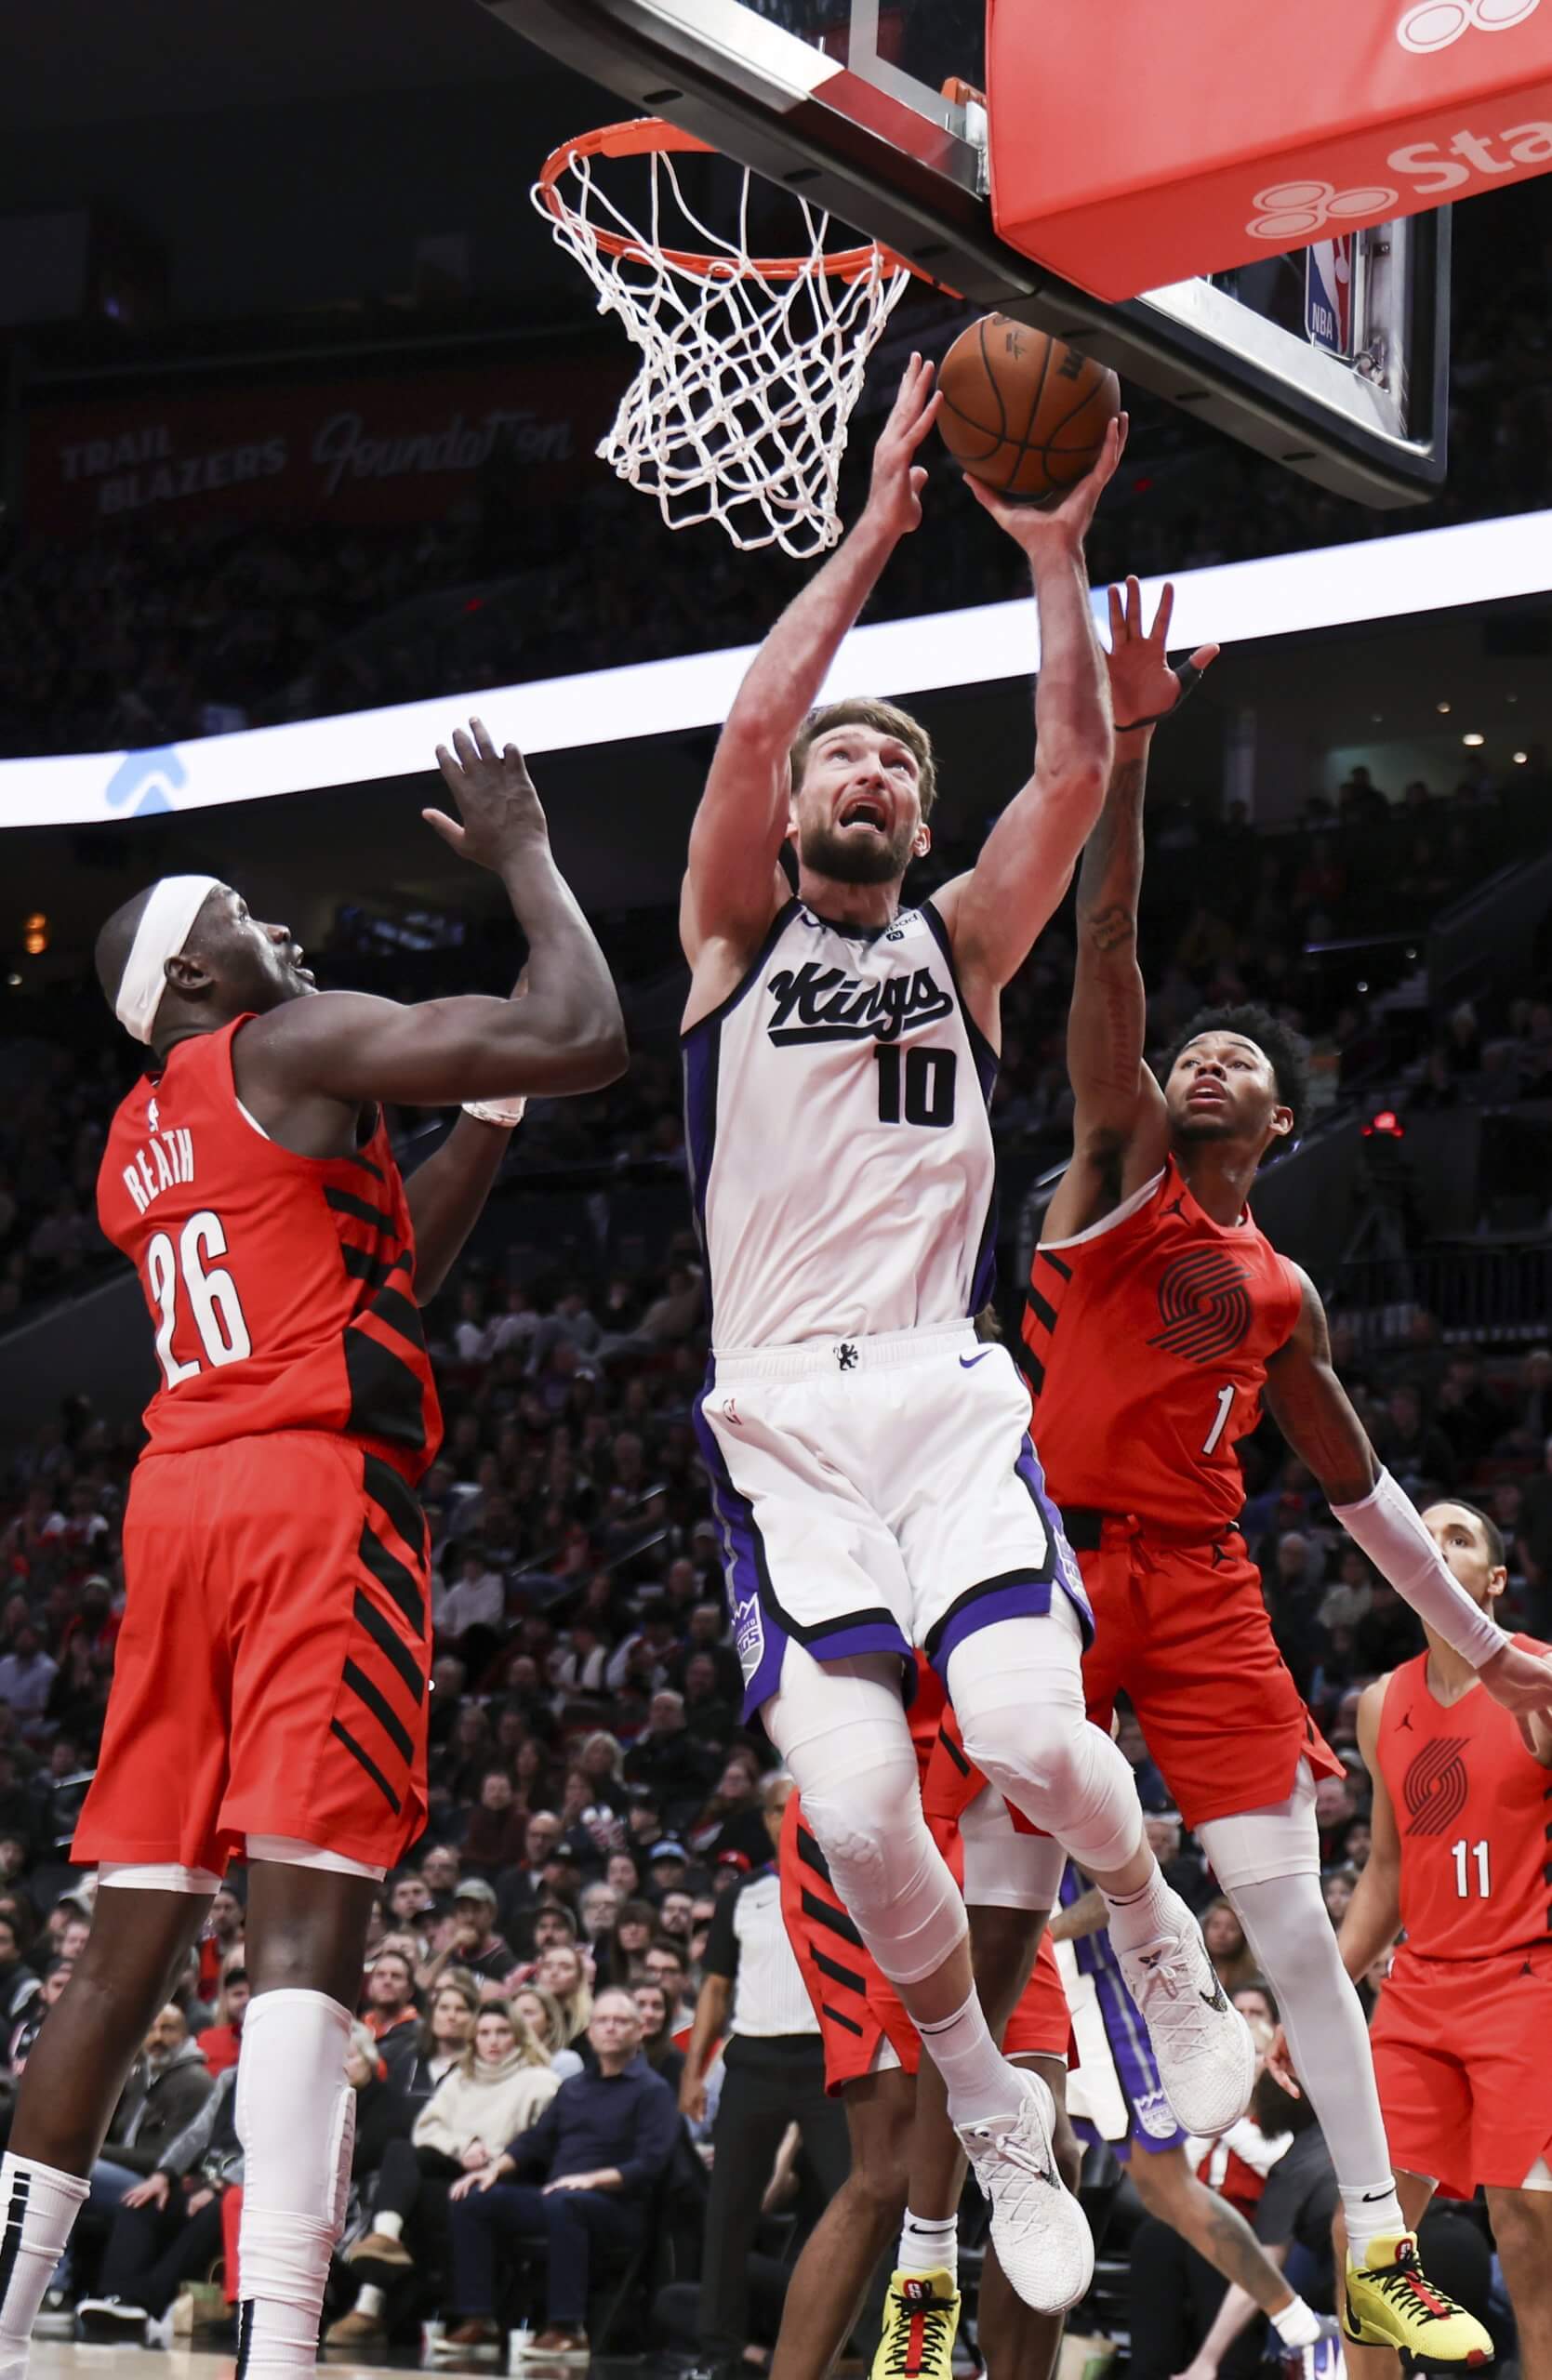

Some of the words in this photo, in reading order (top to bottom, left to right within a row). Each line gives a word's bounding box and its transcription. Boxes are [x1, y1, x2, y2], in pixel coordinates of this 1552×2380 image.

[1386, 122, 1552, 194] Sta
[1311, 302, 1333, 341] NBA
[60, 425, 172, 479] TRAIL
[97, 438, 286, 514] BLAZERS
[312, 410, 574, 496] Foundaton
[766, 961, 954, 1048] Kings
[873, 1043, 957, 1128] 10
[122, 1127, 194, 1216] REATH
[148, 1210, 252, 1391] 26
[1202, 1383, 1235, 1457] 1
[1451, 1839, 1491, 1898] 11
